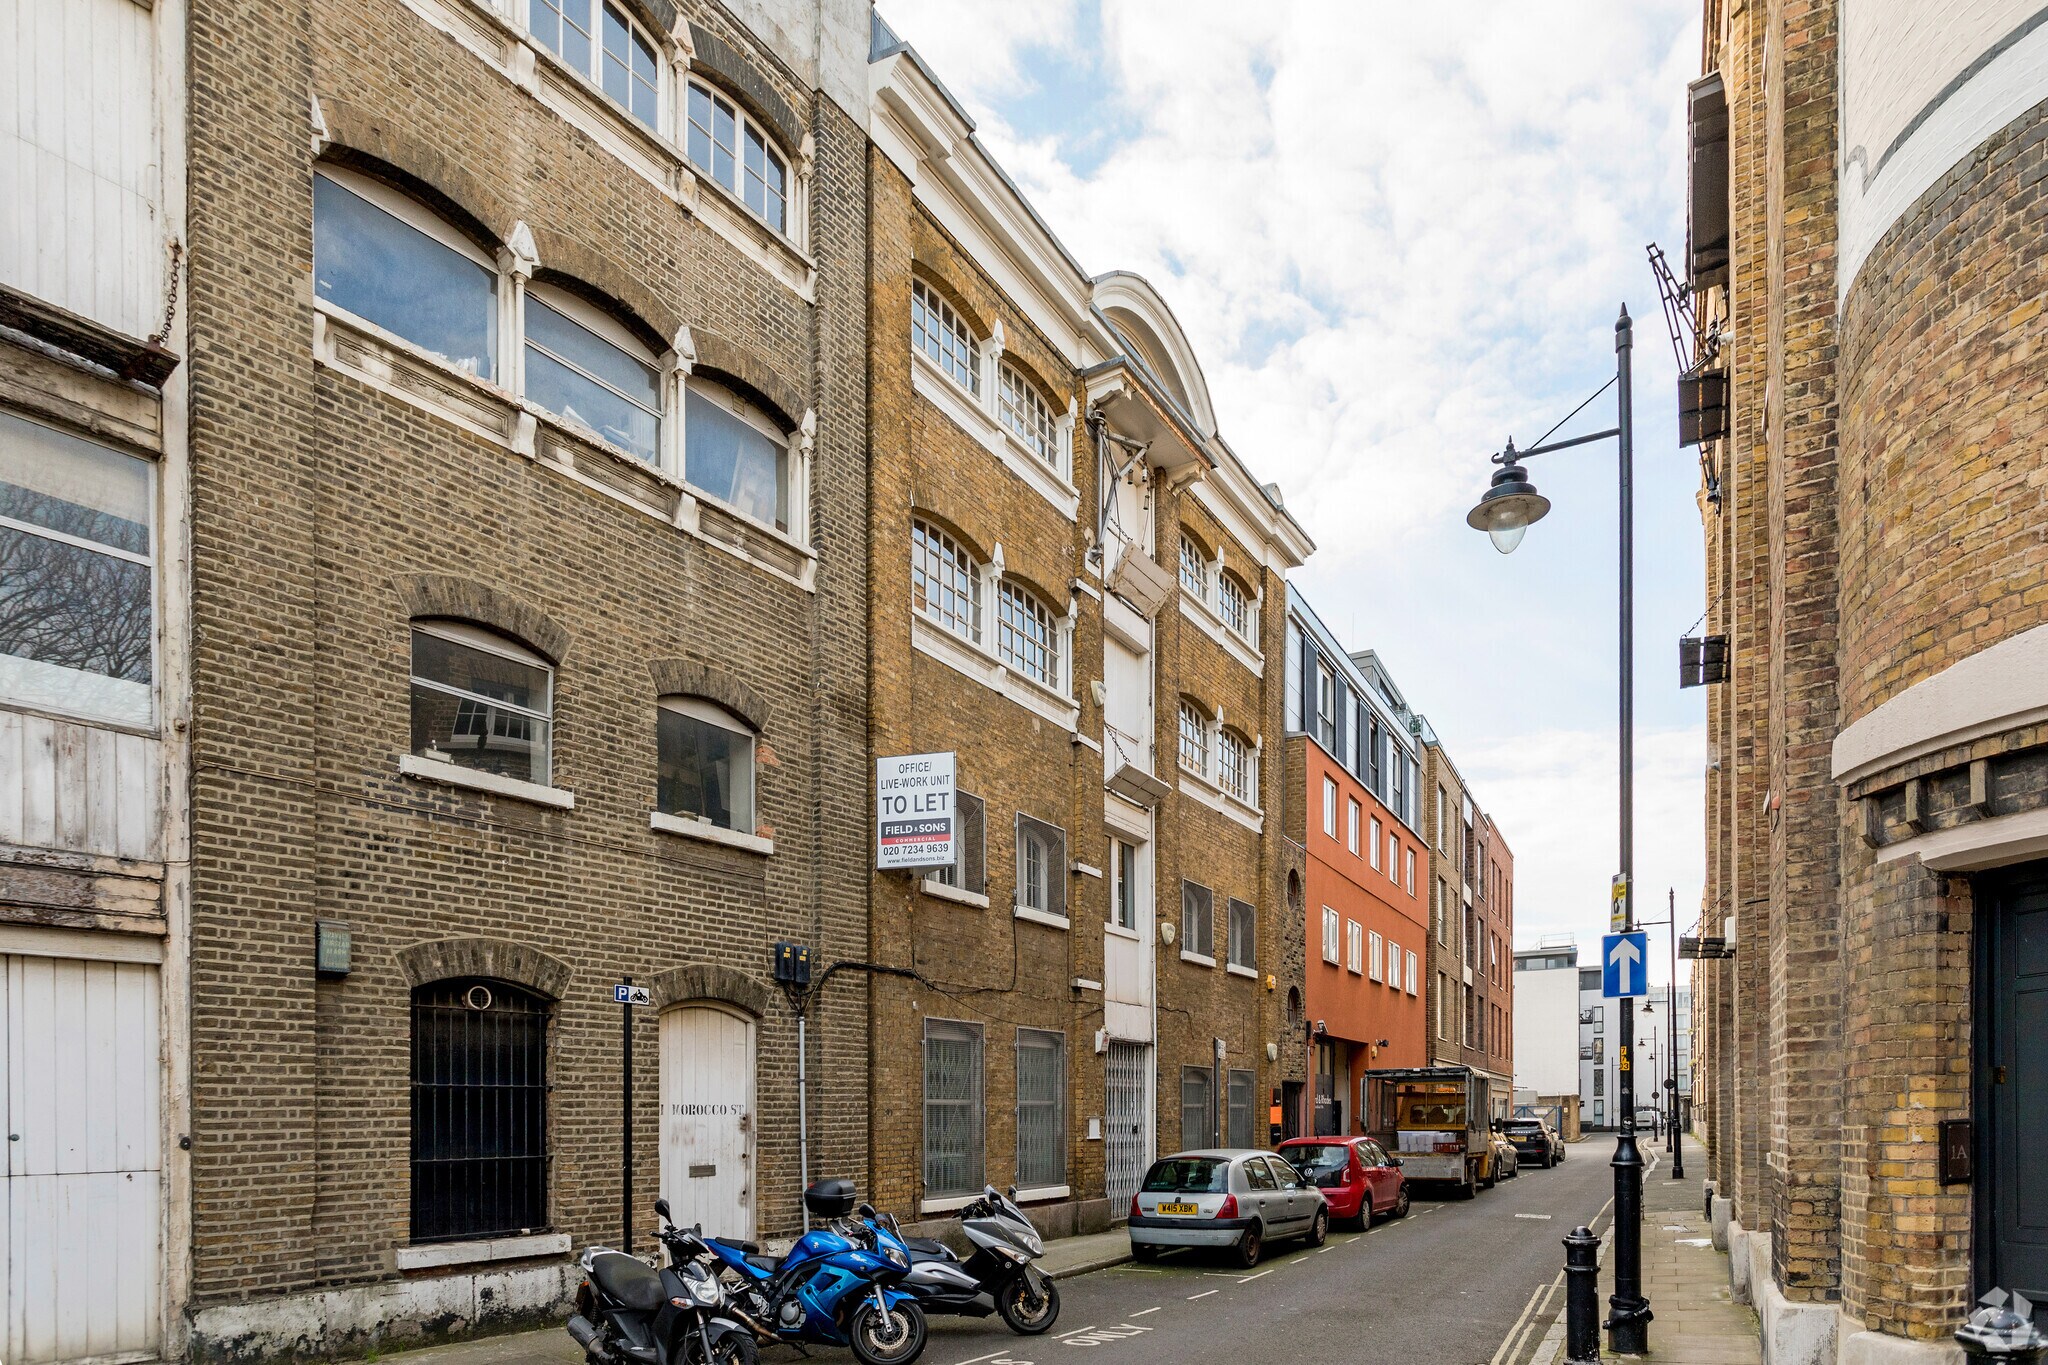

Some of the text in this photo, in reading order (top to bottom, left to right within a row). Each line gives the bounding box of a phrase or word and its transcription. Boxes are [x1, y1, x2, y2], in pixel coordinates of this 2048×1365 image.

[898, 761, 932, 774] OFFICE/
[880, 774, 951, 790] LIVE-WORK UNIT
[882, 792, 950, 815] TO LET
[885, 825, 913, 835] FIELD
[918, 822, 946, 833] SONS
[895, 836, 936, 844] COMMERCIAL
[883, 843, 949, 856] 020 7234 9639
[887, 855, 945, 864] www.fieldandsons.biz
[618, 987, 628, 1000] P
[672, 1104, 727, 1116] MOROCCO
[1951, 1144, 1968, 1160] 1A
[1178, 1204, 1194, 1213] XBK
[1062, 1323, 1154, 1347] ONLY
